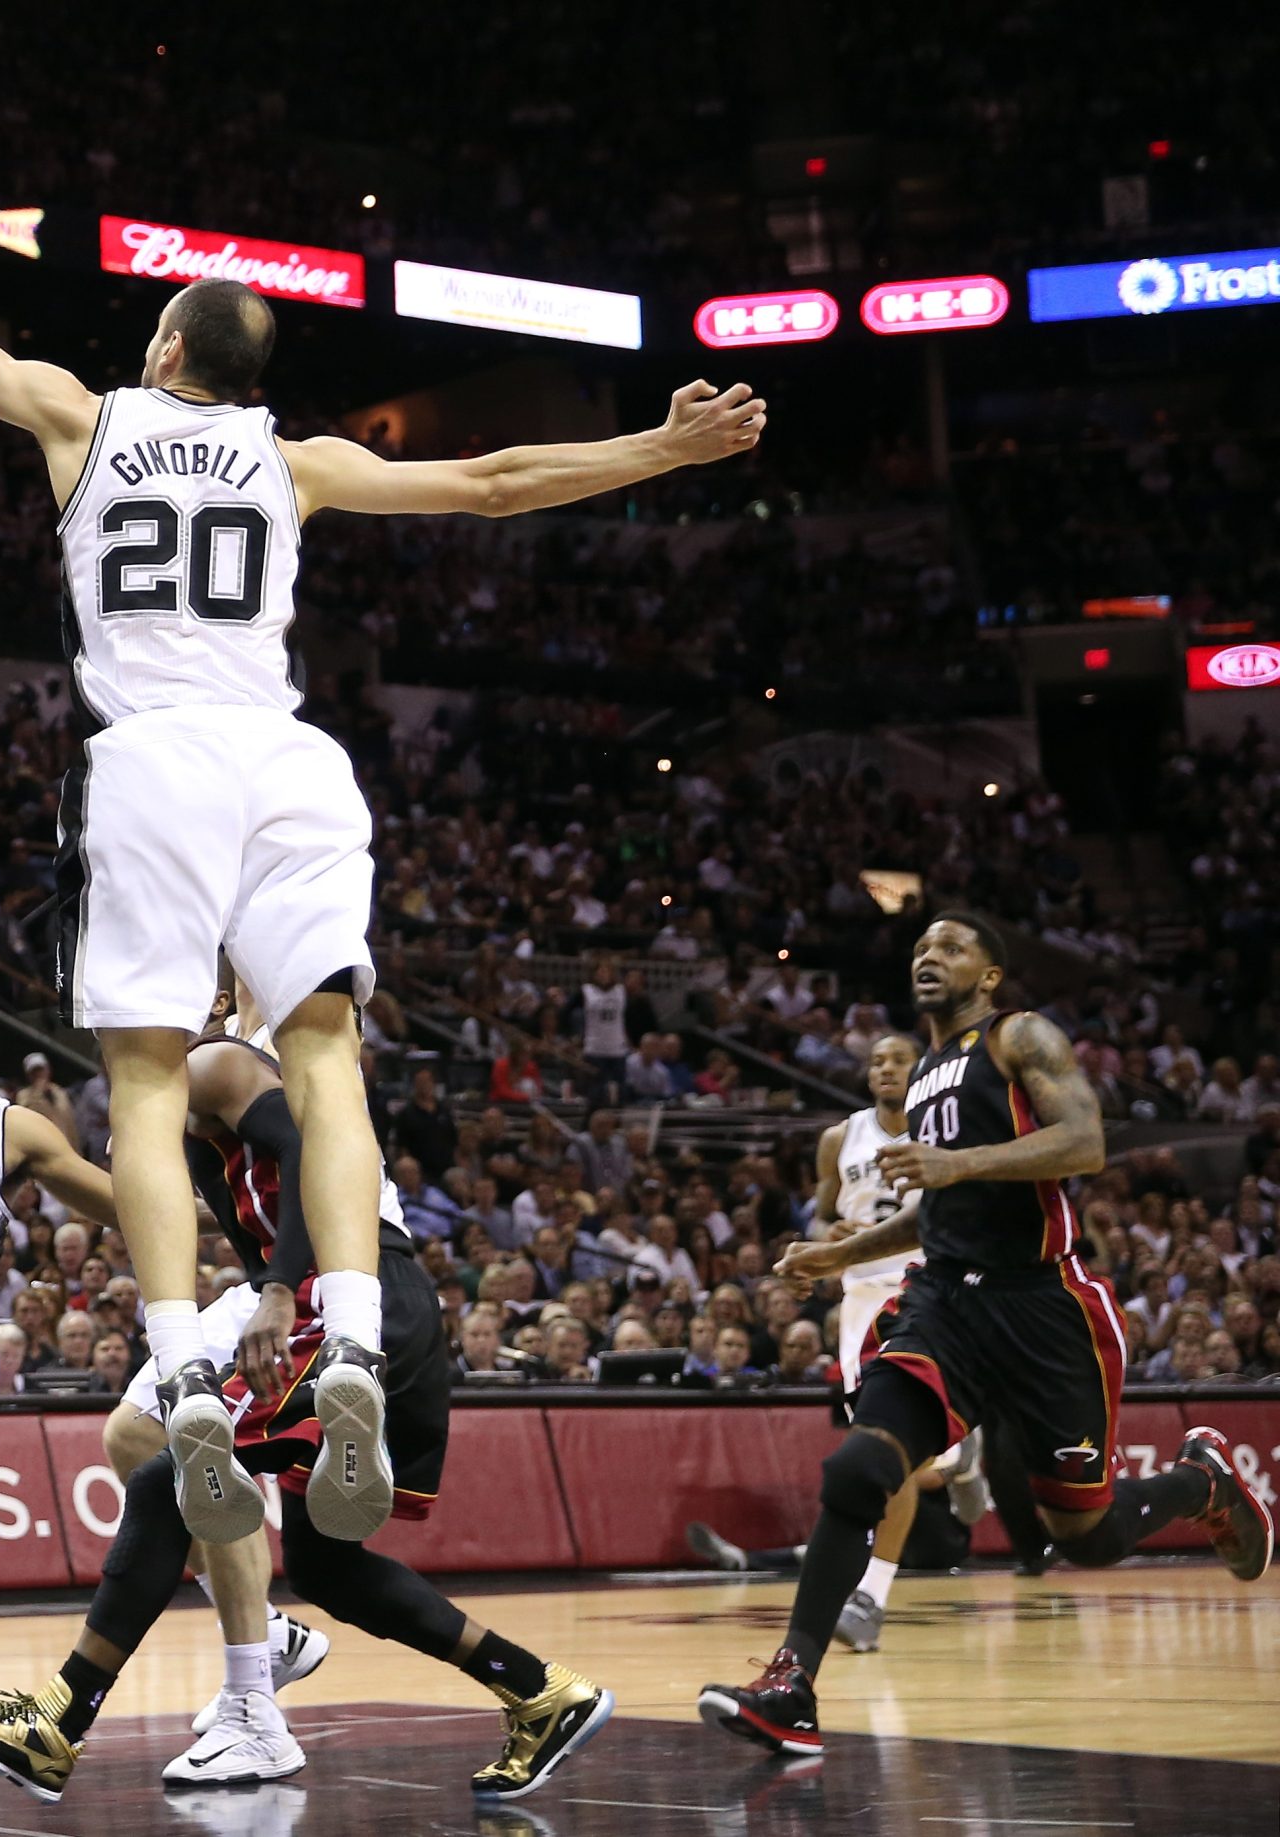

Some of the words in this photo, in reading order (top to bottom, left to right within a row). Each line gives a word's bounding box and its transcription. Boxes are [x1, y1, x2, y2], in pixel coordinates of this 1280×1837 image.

[122, 223, 350, 296] Budweiser
[110, 440, 261, 490] GINOBILI
[97, 495, 274, 626] 20
[1220, 652, 1279, 679] KIA
[904, 1055, 970, 1115] MIAMI
[917, 1095, 960, 1148] 40
